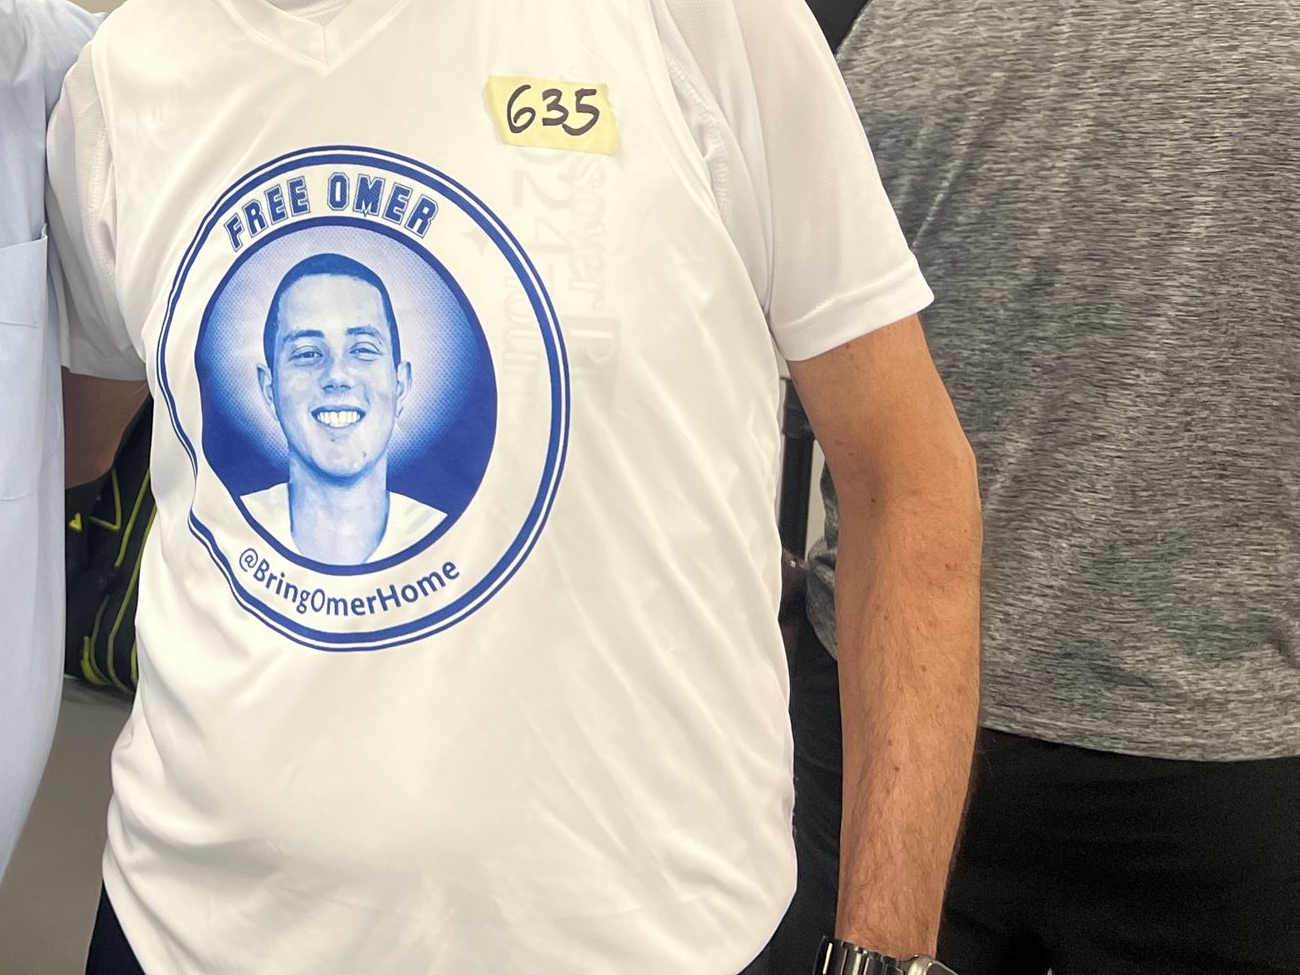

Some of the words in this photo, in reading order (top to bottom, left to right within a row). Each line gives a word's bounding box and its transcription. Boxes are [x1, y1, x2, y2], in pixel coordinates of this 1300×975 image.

[507, 84, 600, 136] 635
[223, 176, 311, 253] FREE
[327, 172, 439, 239] OMER
[238, 547, 461, 617] @BringOmerHome
